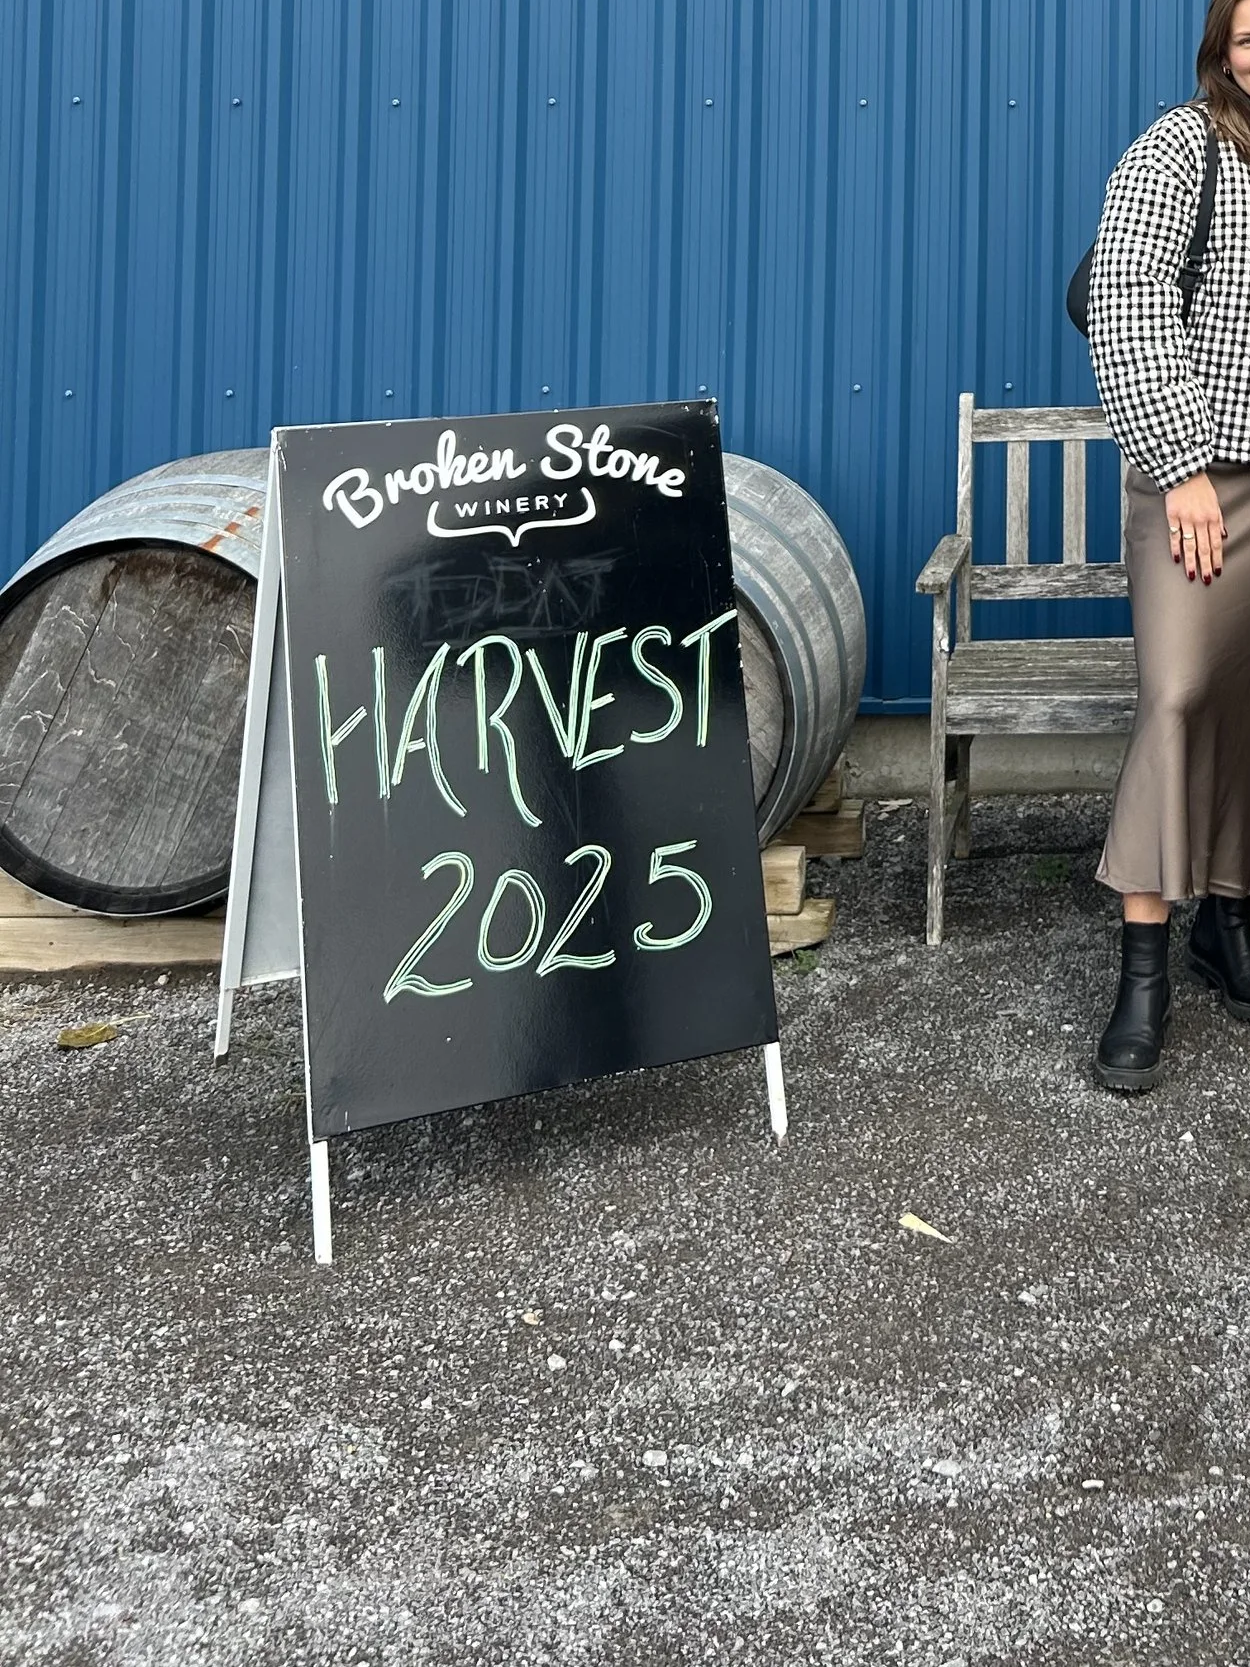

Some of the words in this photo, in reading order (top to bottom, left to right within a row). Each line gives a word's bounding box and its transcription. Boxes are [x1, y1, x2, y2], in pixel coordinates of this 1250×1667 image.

[322, 429, 527, 529] Broken
[540, 423, 686, 498] Stone
[455, 492, 569, 519] WINERY
[314, 609, 738, 827] HARVEST
[384, 840, 713, 1004] 2025
